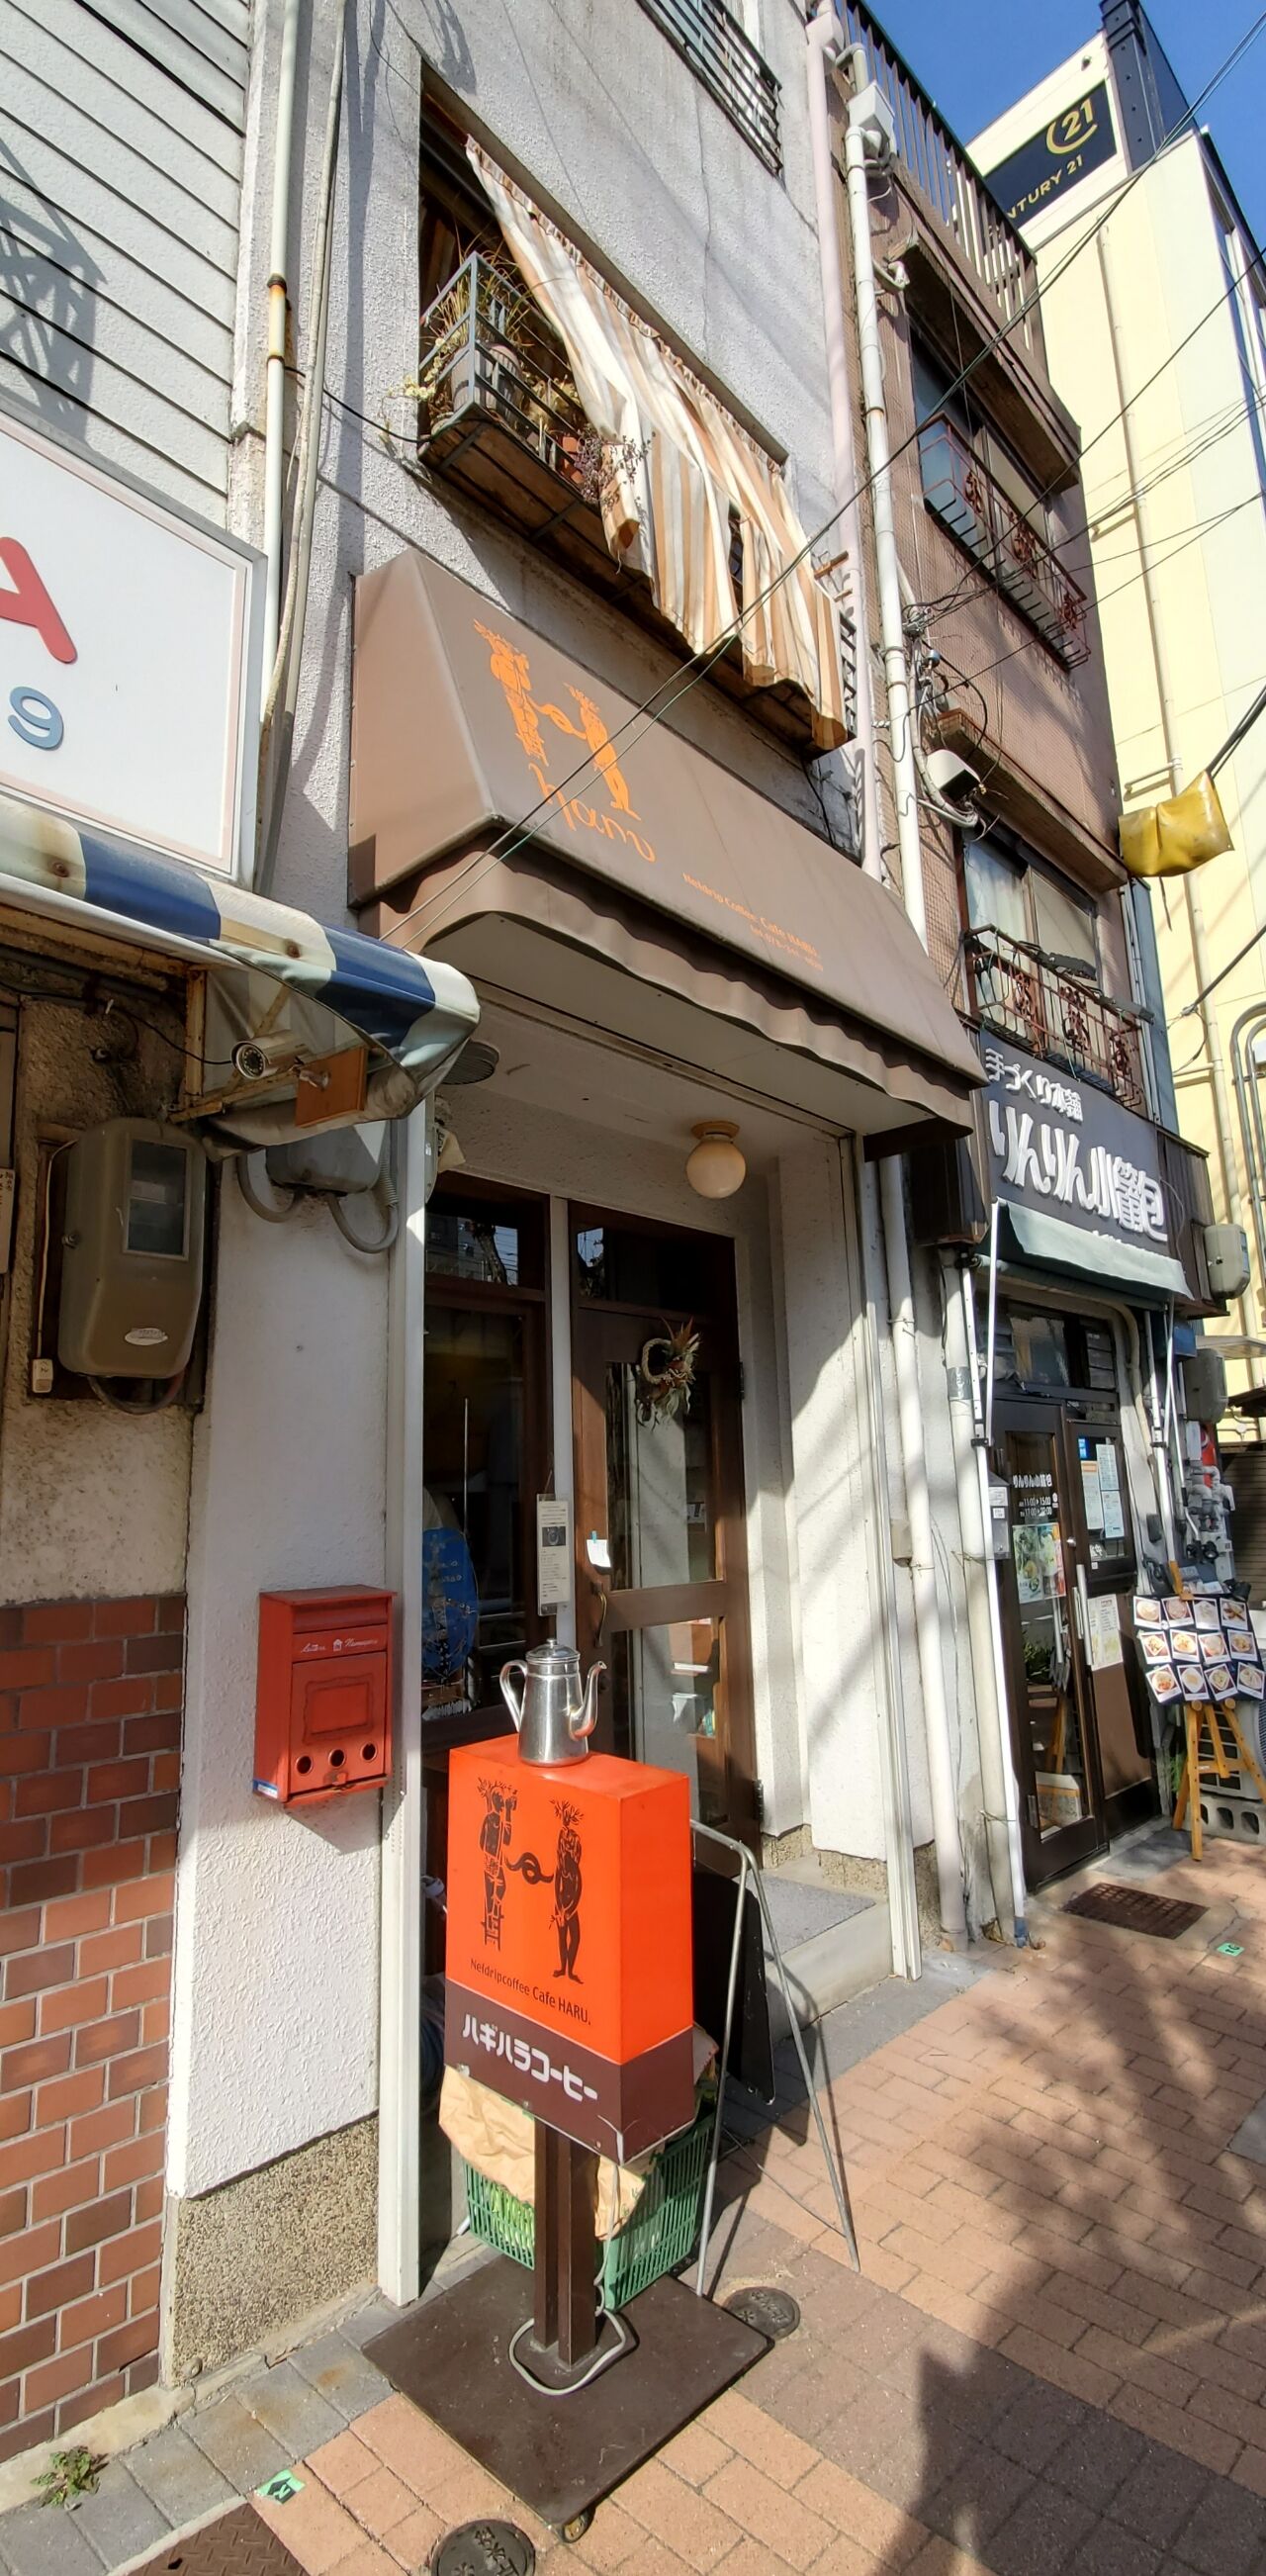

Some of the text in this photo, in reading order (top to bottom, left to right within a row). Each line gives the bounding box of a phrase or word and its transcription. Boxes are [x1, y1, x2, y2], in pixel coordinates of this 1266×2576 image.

[1006, 154, 1083, 220] NTURY 21
[8, 686, 64, 751] 9
[532, 1986, 556, 2008] Cafe
[558, 1997, 591, 2026] HARU.
[462, 2012, 599, 2103] ハギハラコーヒー
